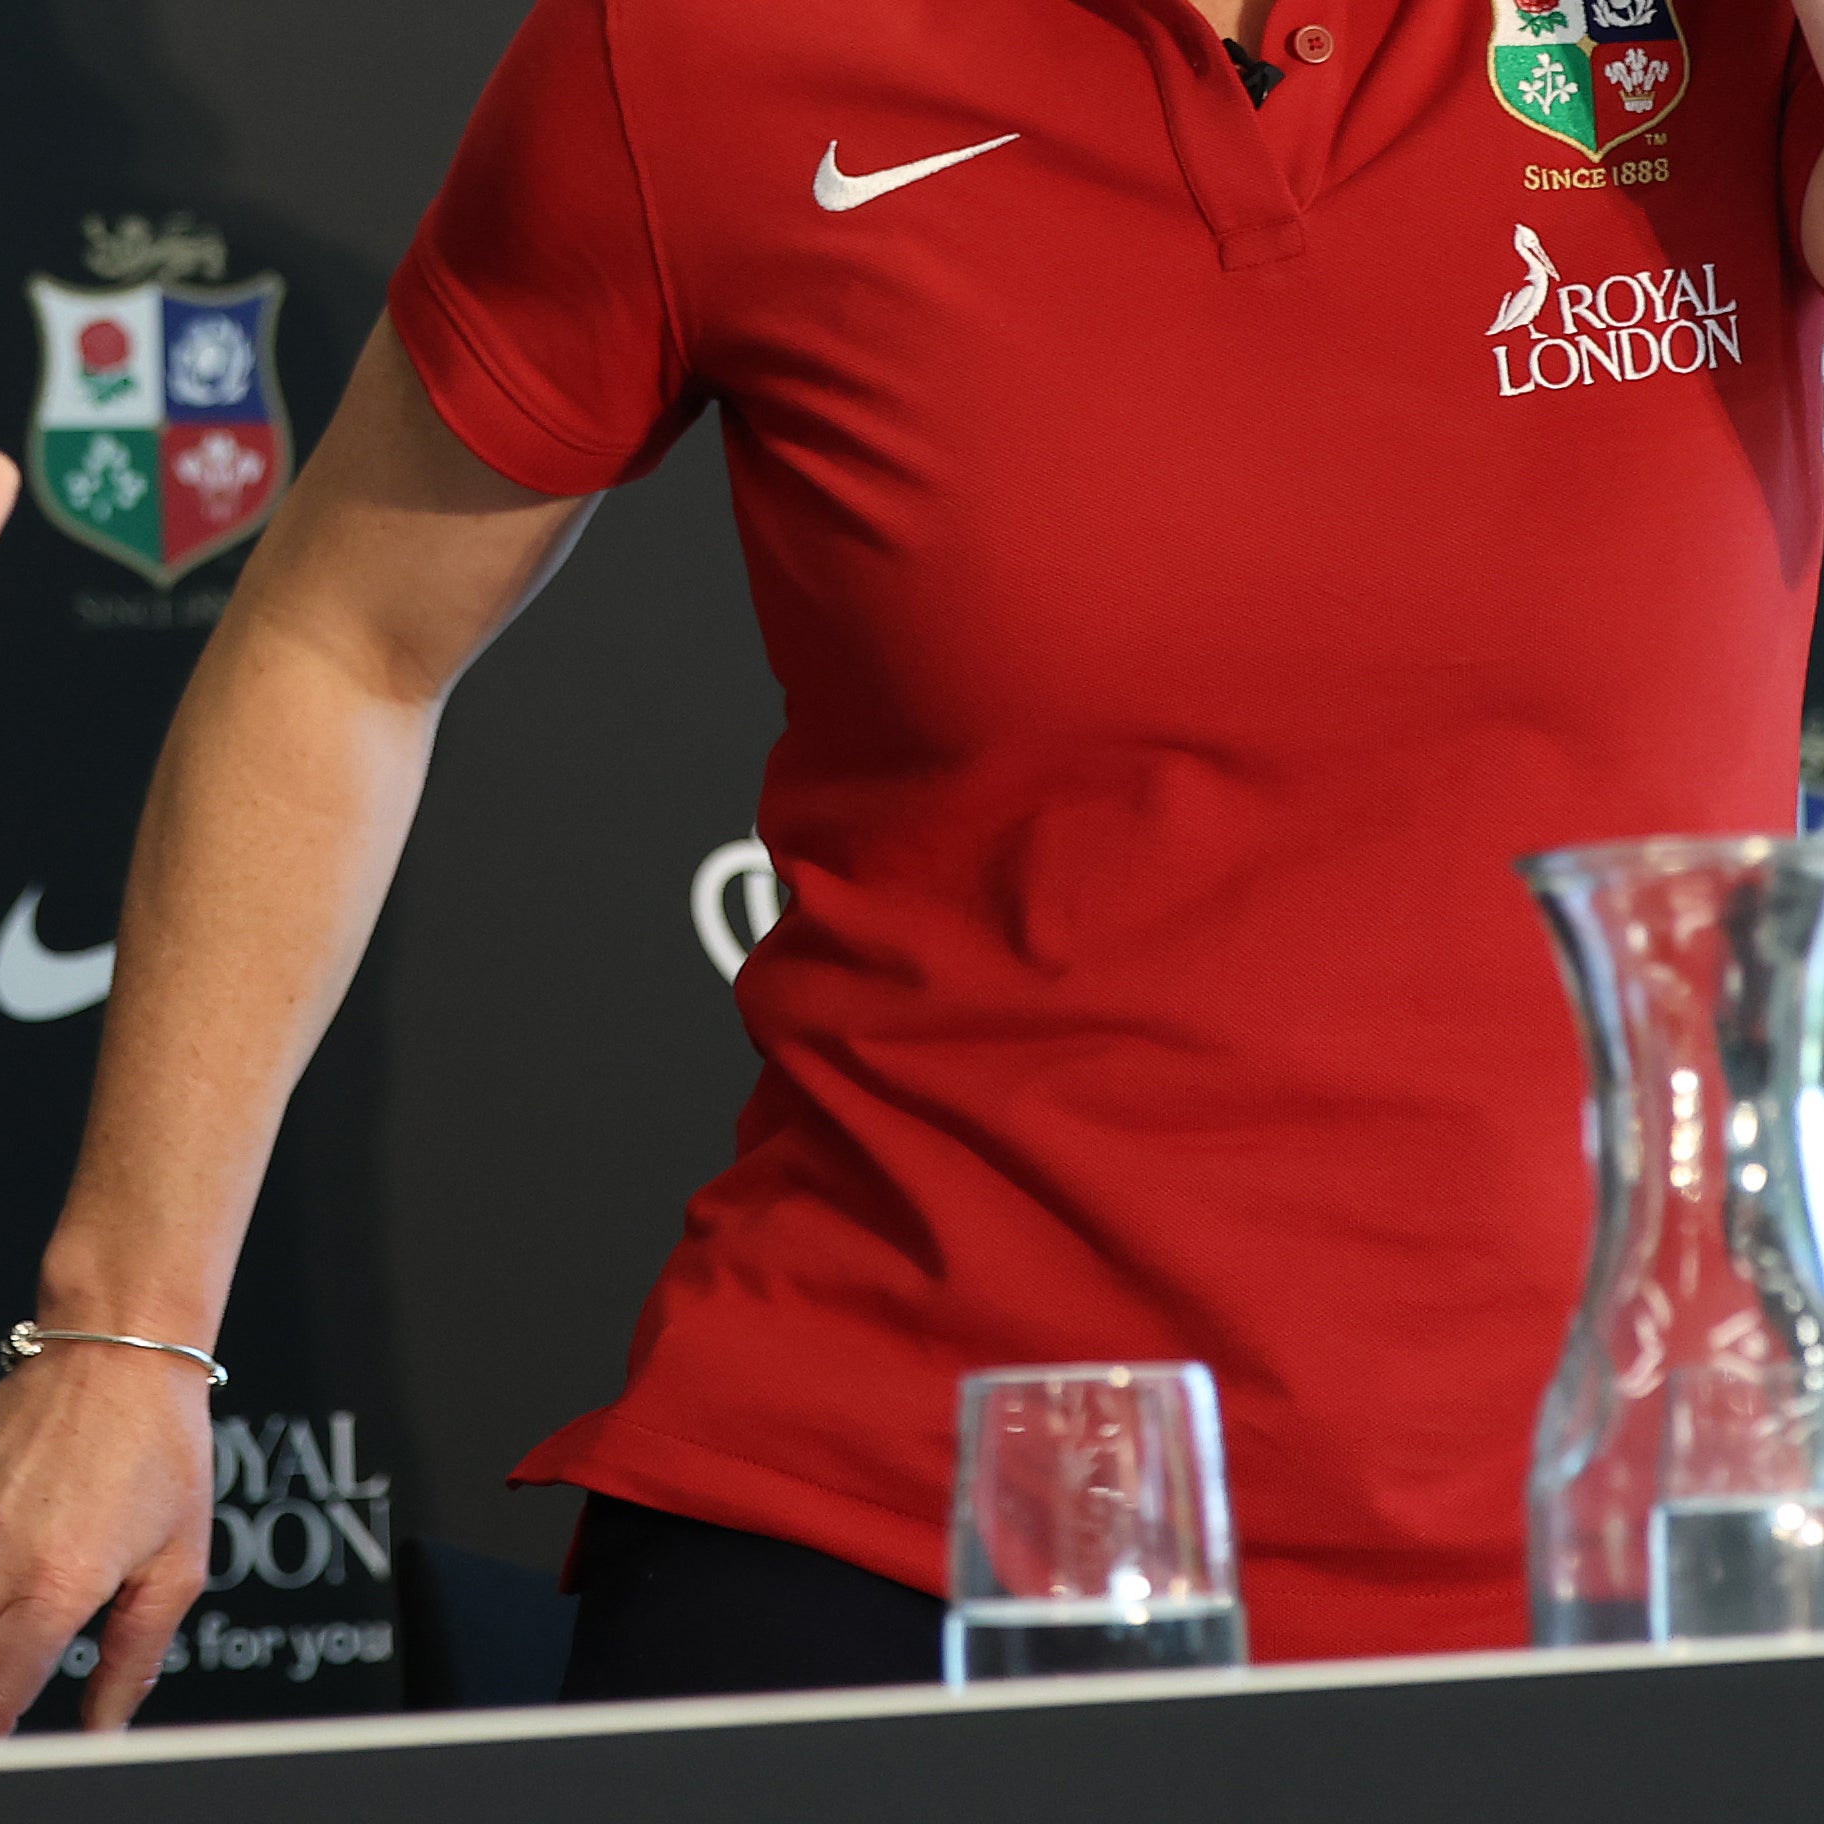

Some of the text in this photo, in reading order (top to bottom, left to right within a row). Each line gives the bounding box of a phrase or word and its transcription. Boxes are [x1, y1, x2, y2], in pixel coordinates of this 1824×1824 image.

[1524, 157, 1670, 191] SINCE 1888
[1556, 263, 1738, 335] ROYAL
[1492, 314, 1743, 398] LONDON
[196, 1610, 285, 1672] for
[285, 1620, 394, 1682] you
